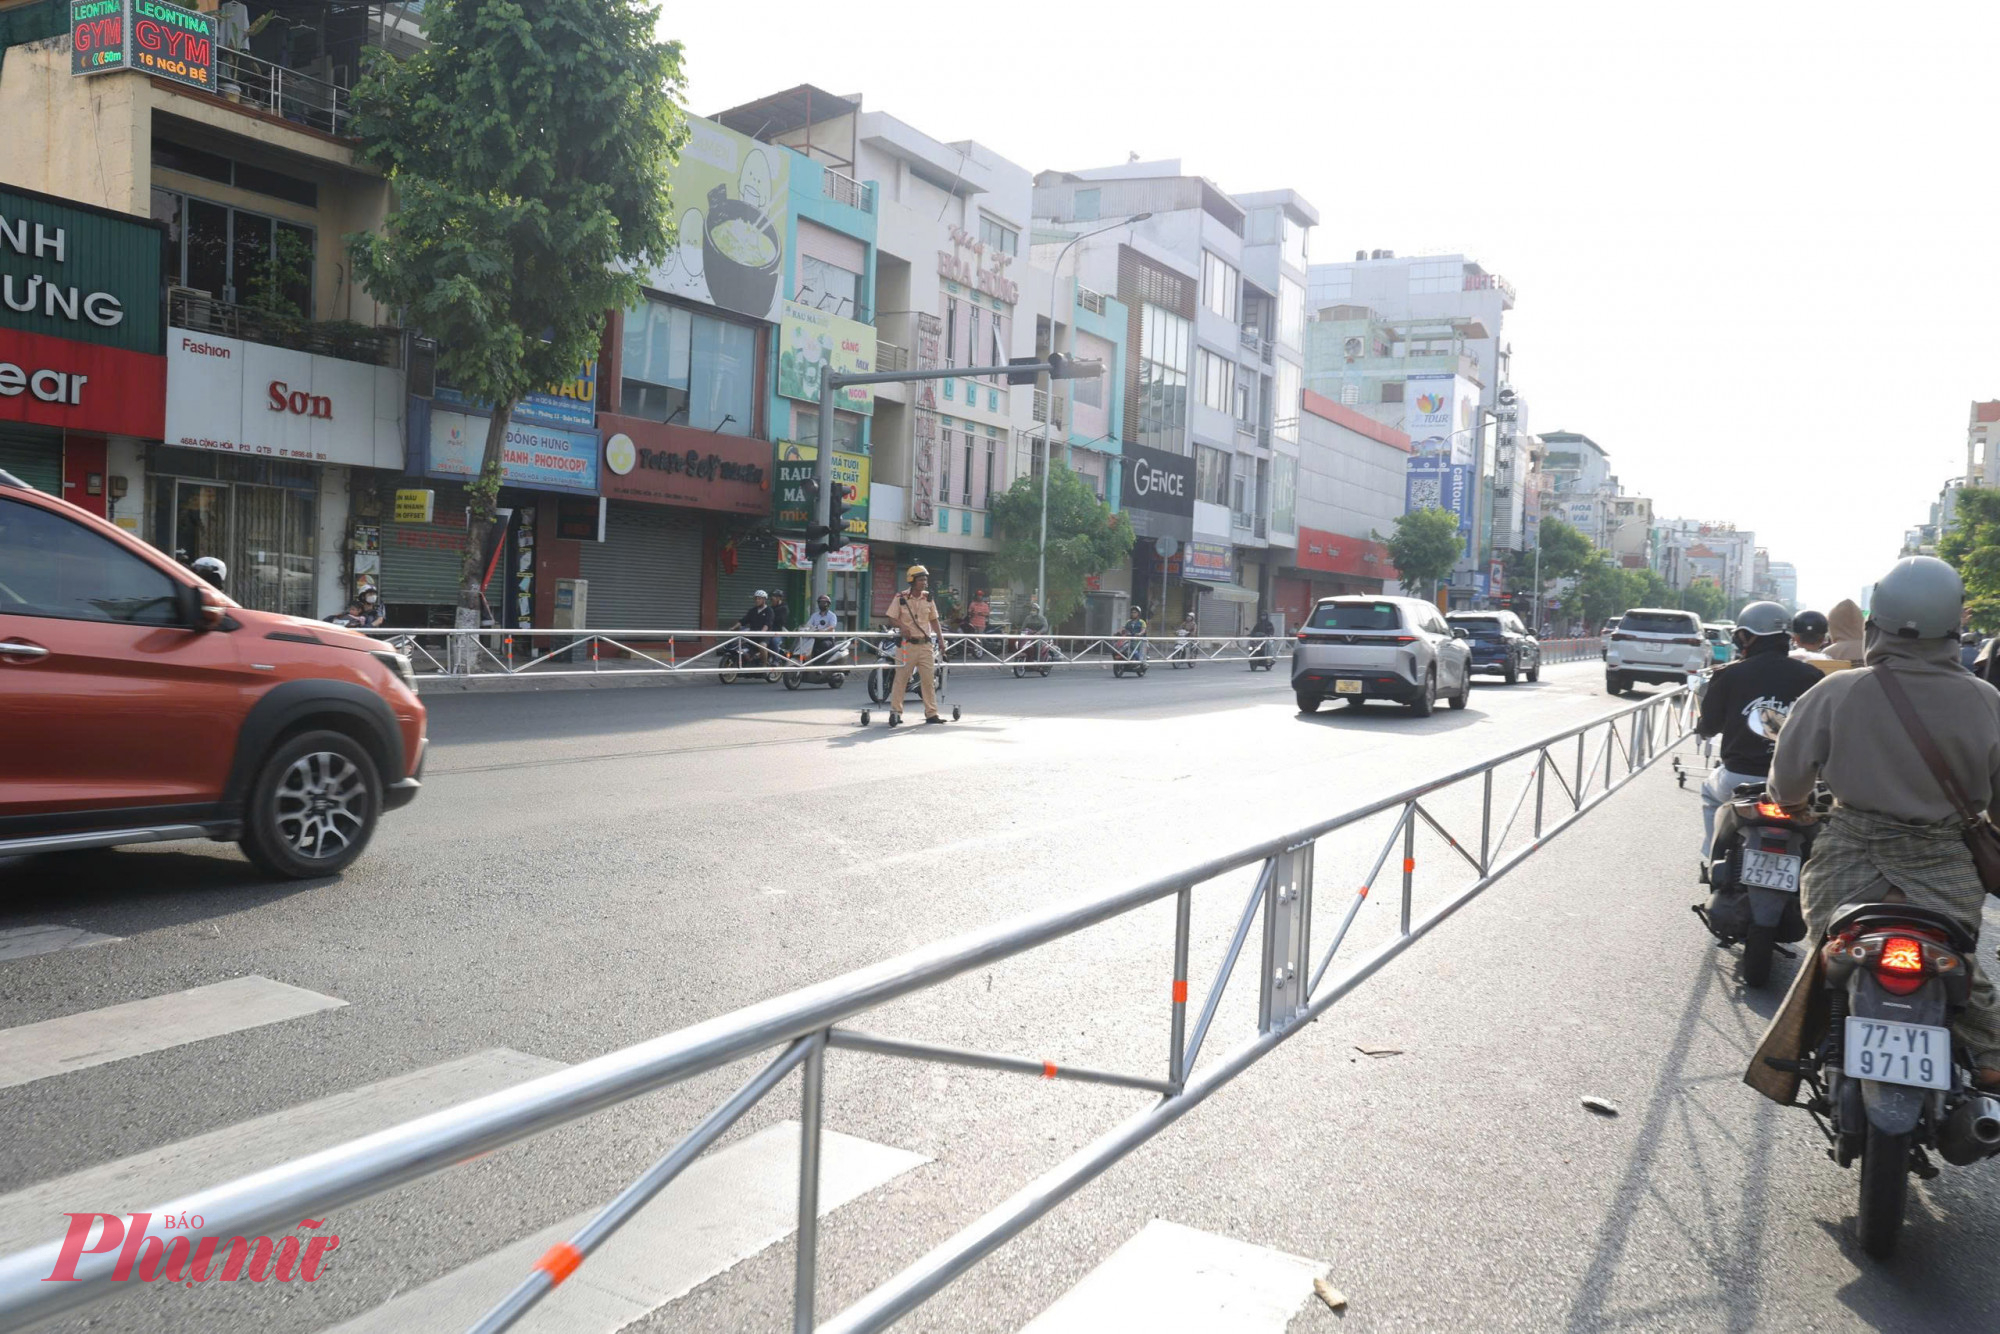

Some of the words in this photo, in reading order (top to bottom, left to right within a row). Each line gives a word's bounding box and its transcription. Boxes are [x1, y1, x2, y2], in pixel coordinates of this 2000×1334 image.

[74, 0, 121, 21] LEONTINA
[135, 0, 209, 36] LEONTINA
[75, 16, 121, 51] GYM
[136, 20, 209, 67] GYM
[139, 52, 153, 66] 16
[157, 57, 186, 76] NGÔ
[189, 66, 207, 84] BỆ
[182, 338, 231, 359] Fashion
[268, 381, 333, 421] Sơn
[849, 388, 867, 399] NGON
[1424, 414, 1449, 424] TOUR
[534, 453, 587, 473] PHOTOCOPY
[780, 467, 812, 481] RAU
[1134, 458, 1184, 496] GENCE
[784, 485, 806, 501] MÁ
[781, 507, 808, 522] mix
[1753, 853, 1792, 872] 77-L2
[1746, 868, 1794, 888] 257.79
[1861, 1023, 1929, 1055] 77-Y1
[1861, 1050, 1933, 1083] 9719
